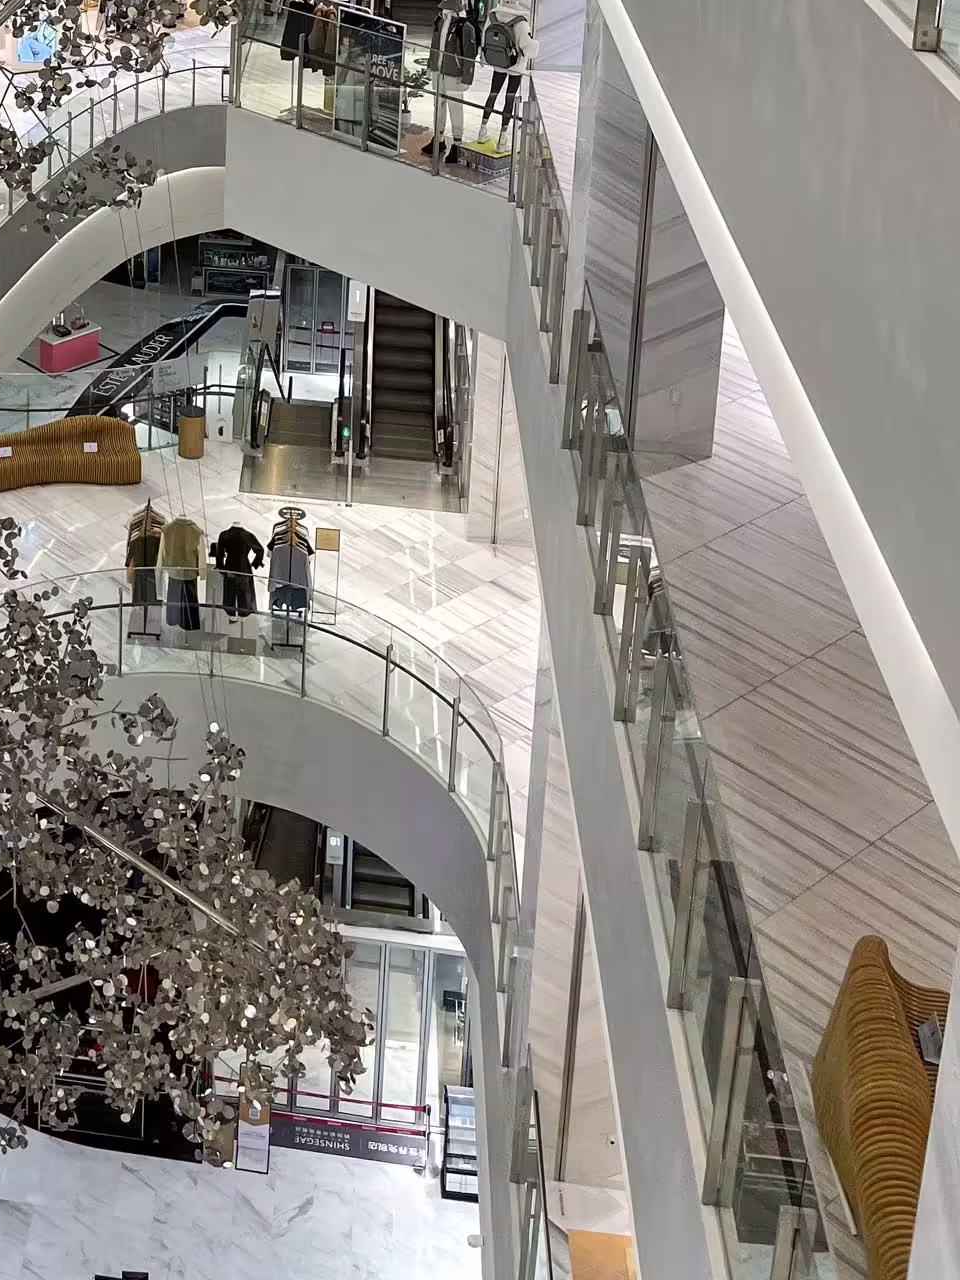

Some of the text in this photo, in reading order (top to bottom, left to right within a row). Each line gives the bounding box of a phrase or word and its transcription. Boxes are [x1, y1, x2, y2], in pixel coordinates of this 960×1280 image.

[369, 53, 387, 65] REE
[355, 289, 360, 304] 1
[293, 1135, 350, 1151] SHINSEGAE
